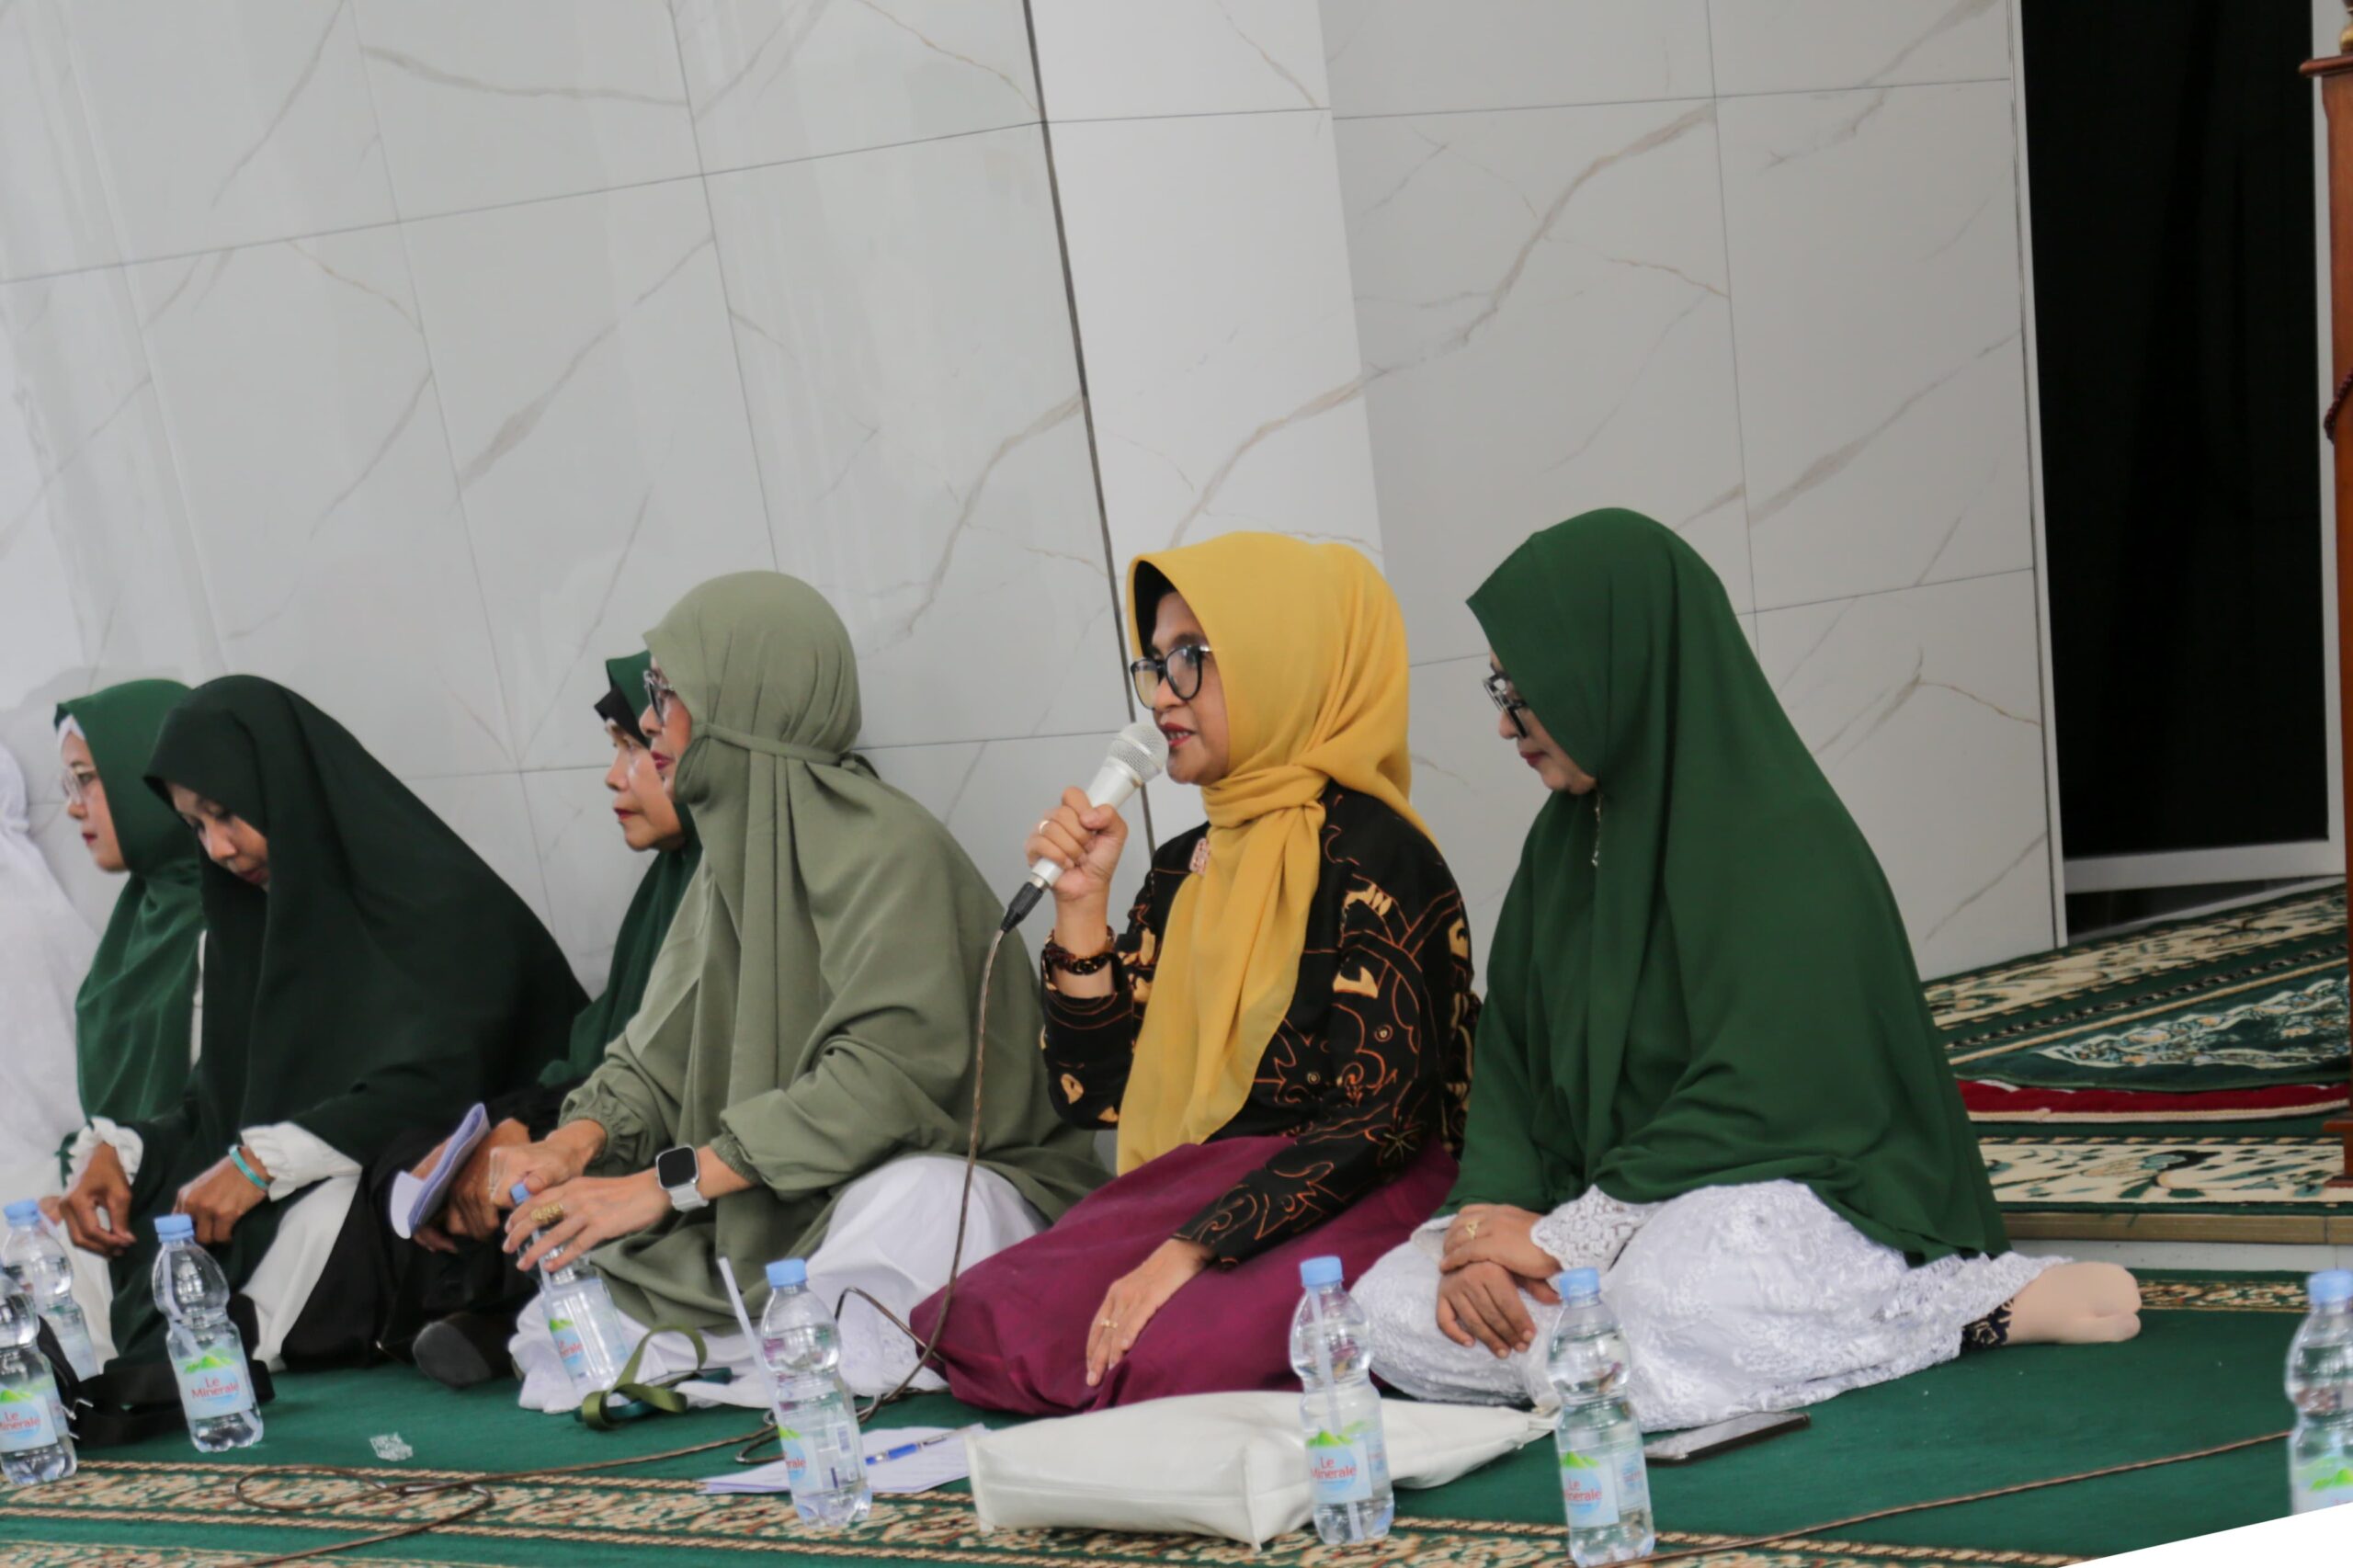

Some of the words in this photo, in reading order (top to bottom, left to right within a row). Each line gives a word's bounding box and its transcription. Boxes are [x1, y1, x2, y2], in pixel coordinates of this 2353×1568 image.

[191, 1381, 240, 1398] Minerale
[205, 1377, 220, 1388] Le
[0, 1416, 40, 1431] inerale
[4, 1411, 19, 1422] Le
[1320, 1456, 1335, 1469] Le
[1311, 1465, 1358, 1481] Minerale
[1567, 1477, 1581, 1491] Le
